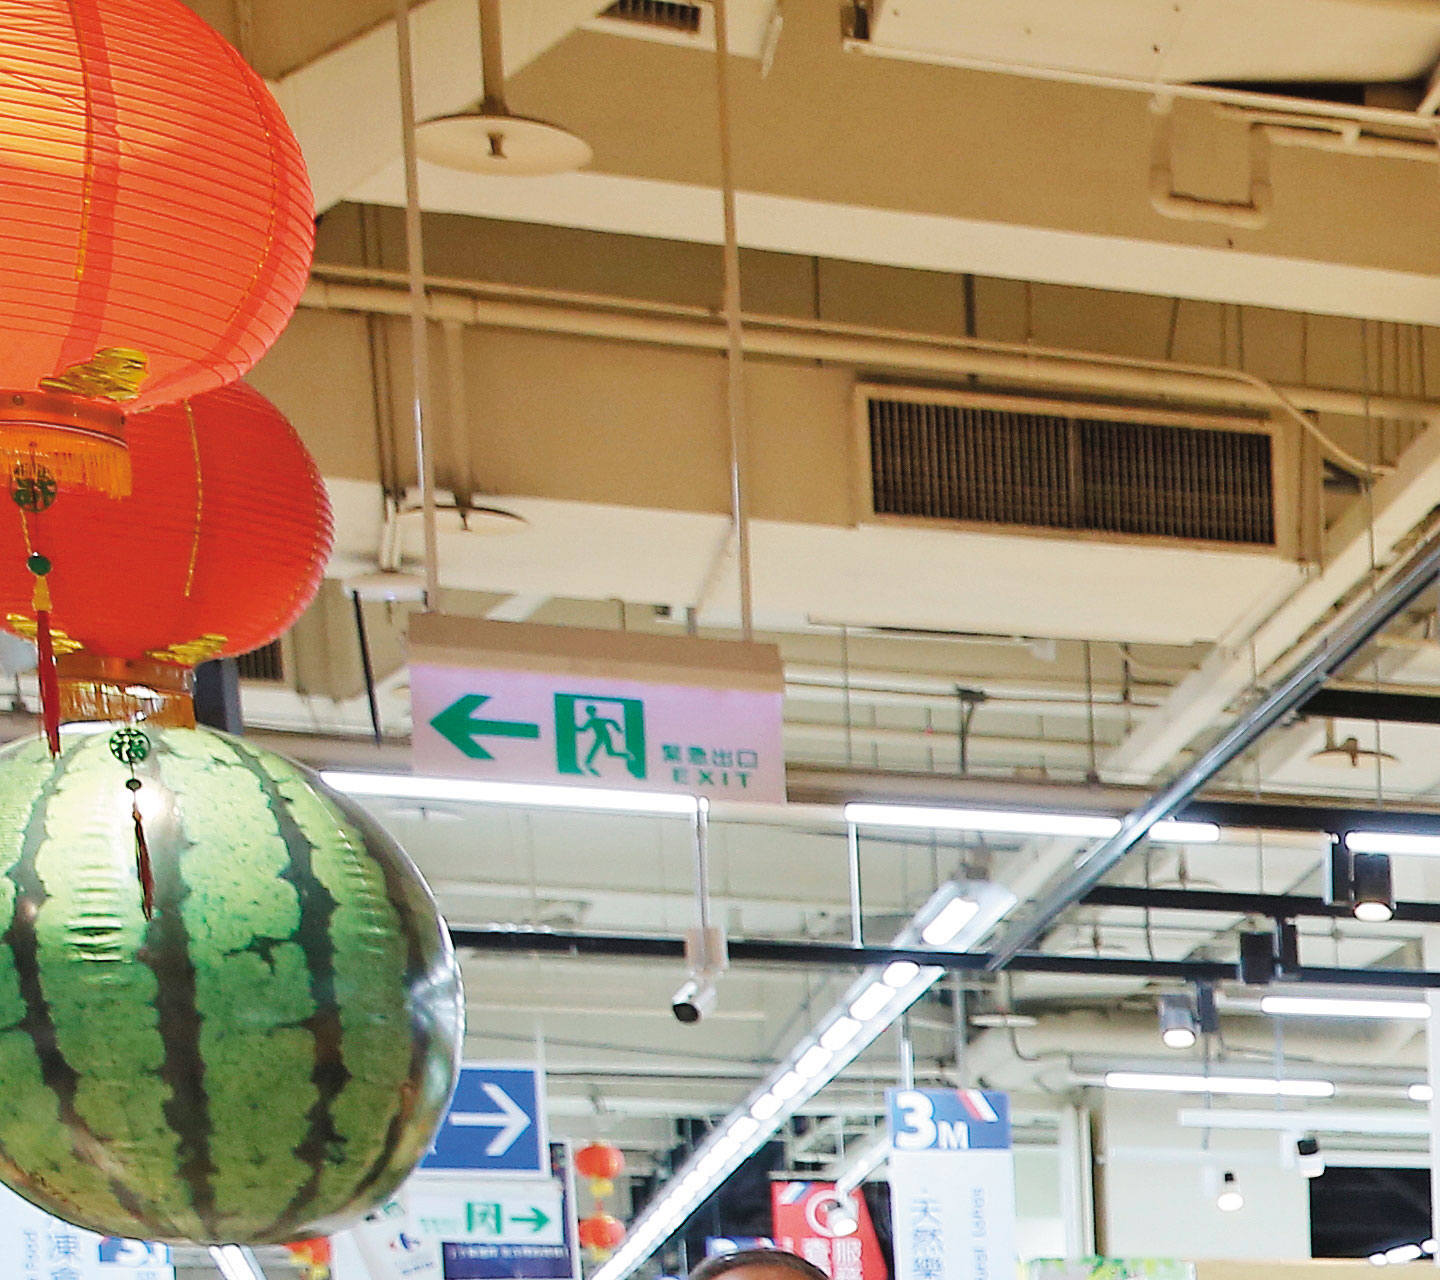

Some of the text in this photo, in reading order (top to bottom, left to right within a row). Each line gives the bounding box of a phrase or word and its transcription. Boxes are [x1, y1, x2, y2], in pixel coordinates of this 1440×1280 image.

[662, 744, 758, 768] 緊急出口
[672, 766, 752, 788] EXIT
